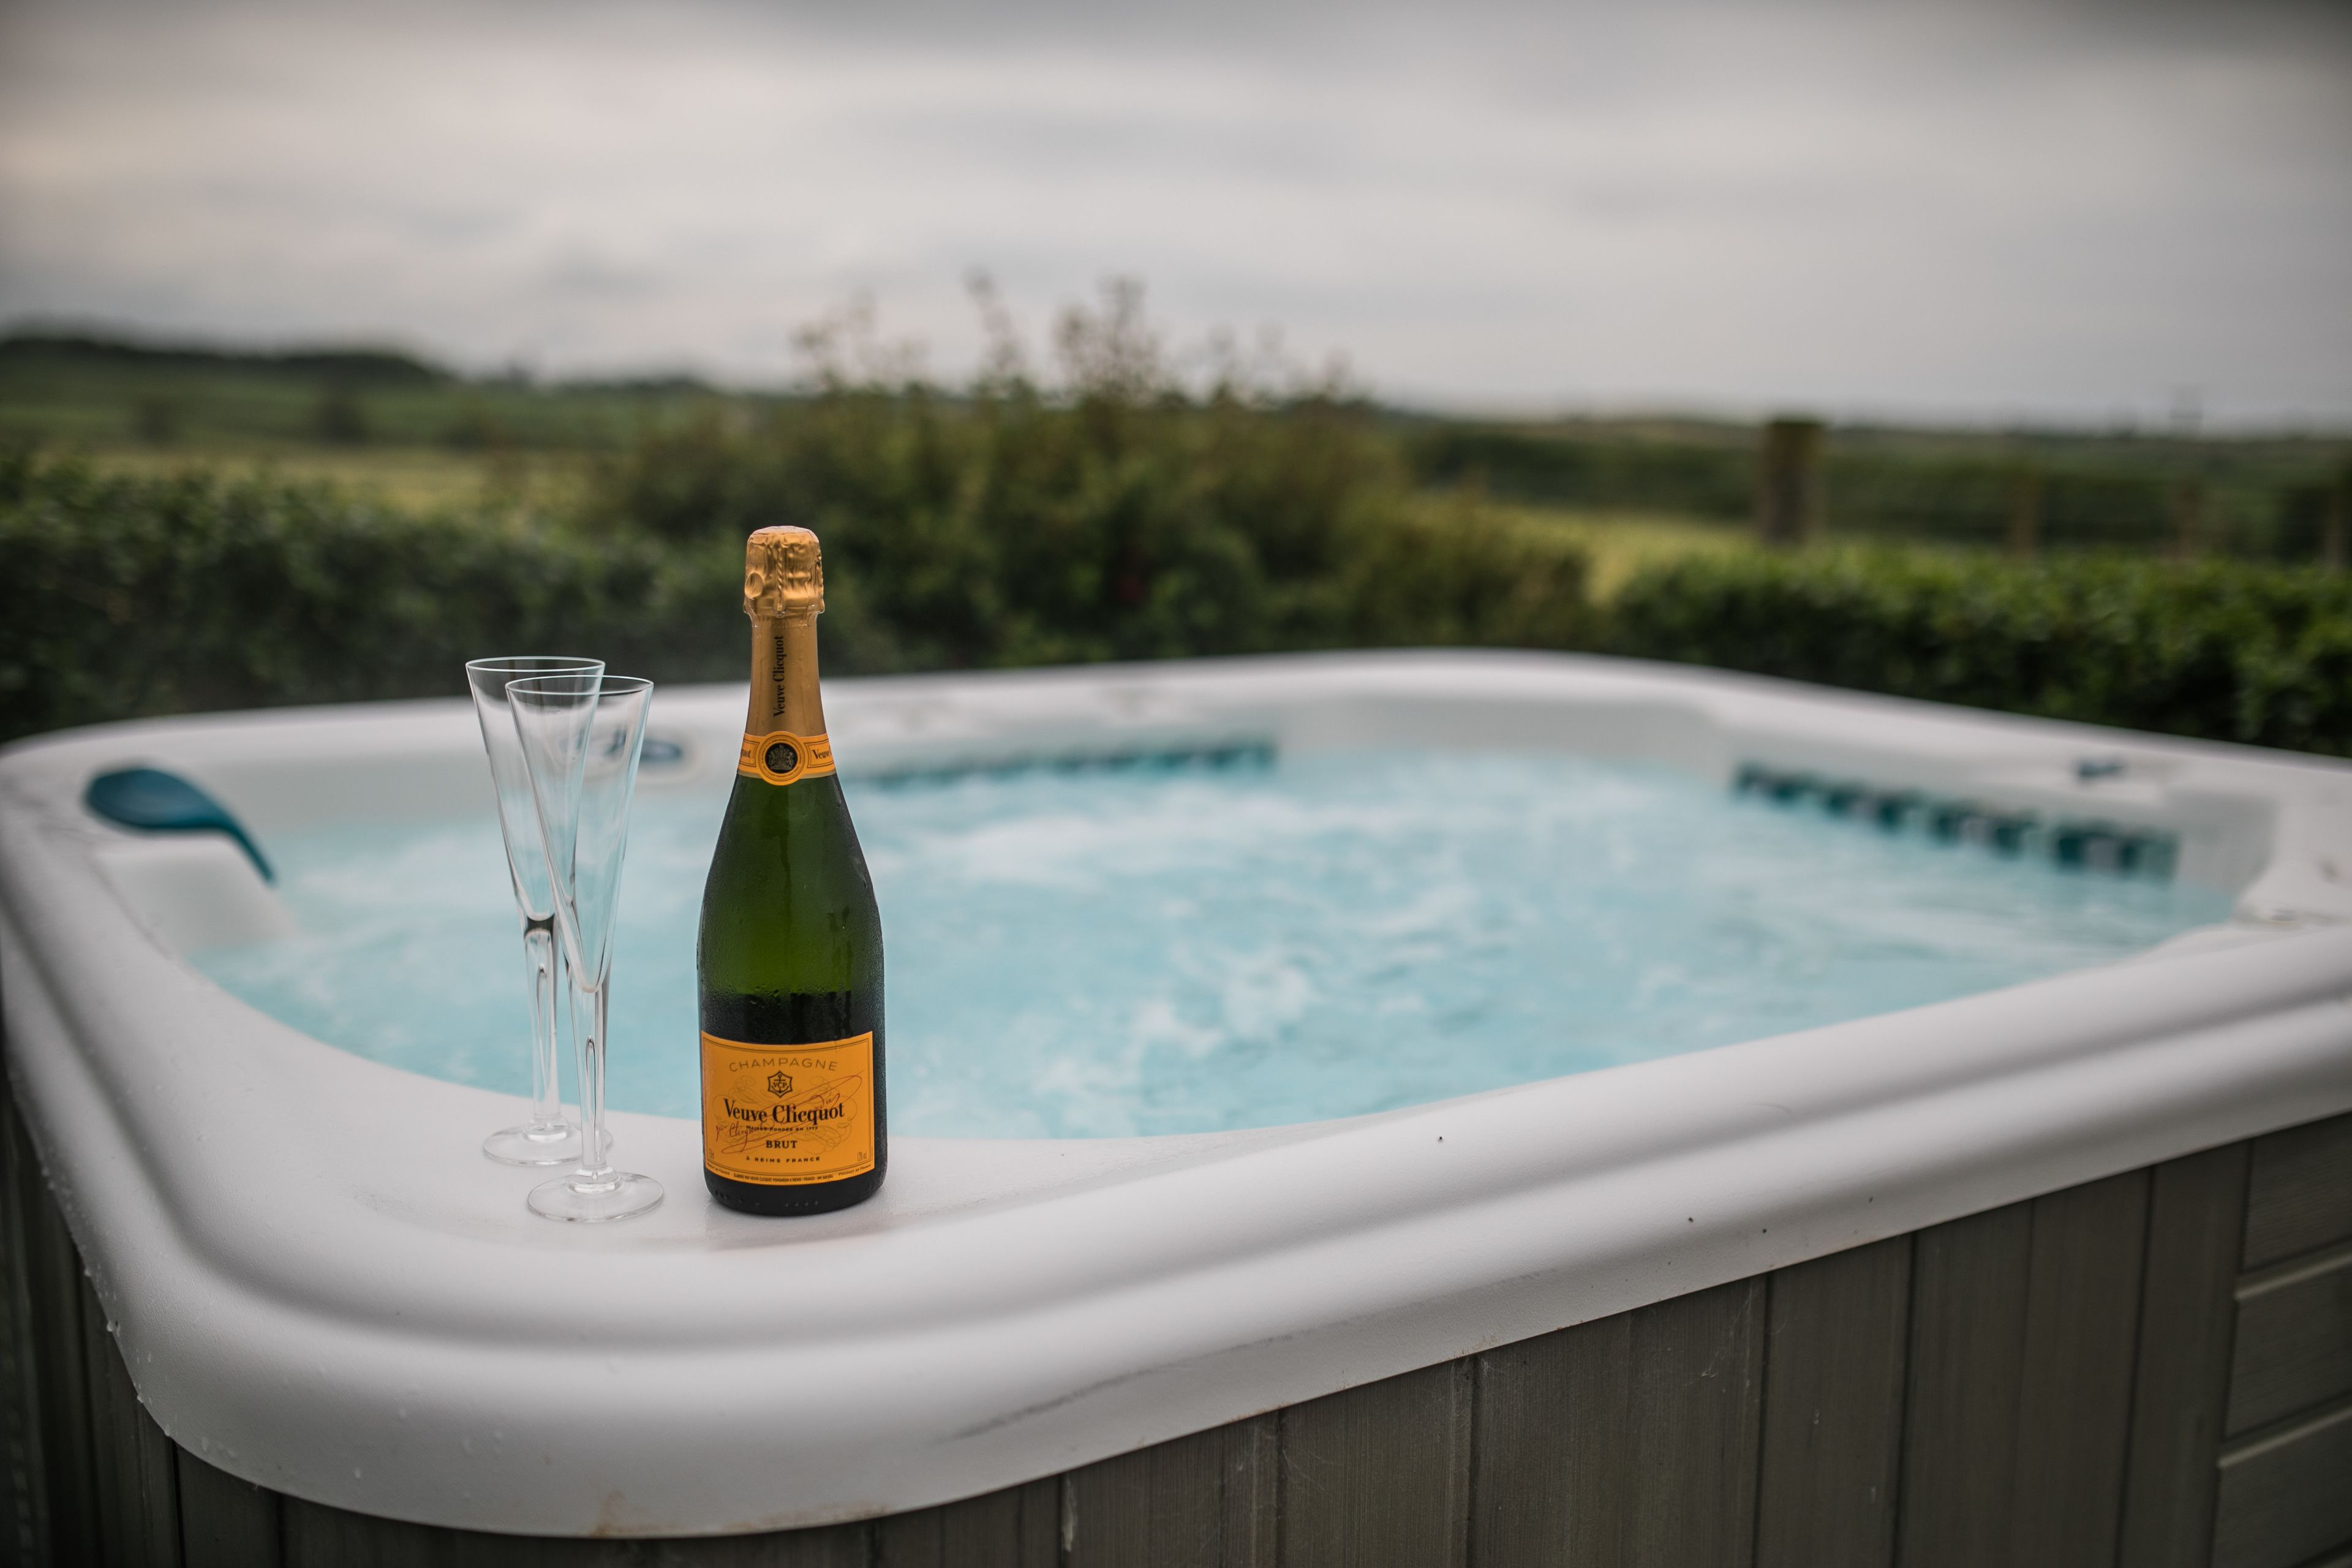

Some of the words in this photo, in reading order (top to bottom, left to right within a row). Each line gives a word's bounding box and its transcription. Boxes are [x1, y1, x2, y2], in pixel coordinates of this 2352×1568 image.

[772, 636, 786, 682] Clicquot
[773, 685, 785, 717] Veuve
[729, 1057, 838, 1072] CHAMPAGNE
[723, 1098, 767, 1122] Veuve
[772, 1102, 845, 1125] Clicquot
[766, 1140, 797, 1148] BRUT
